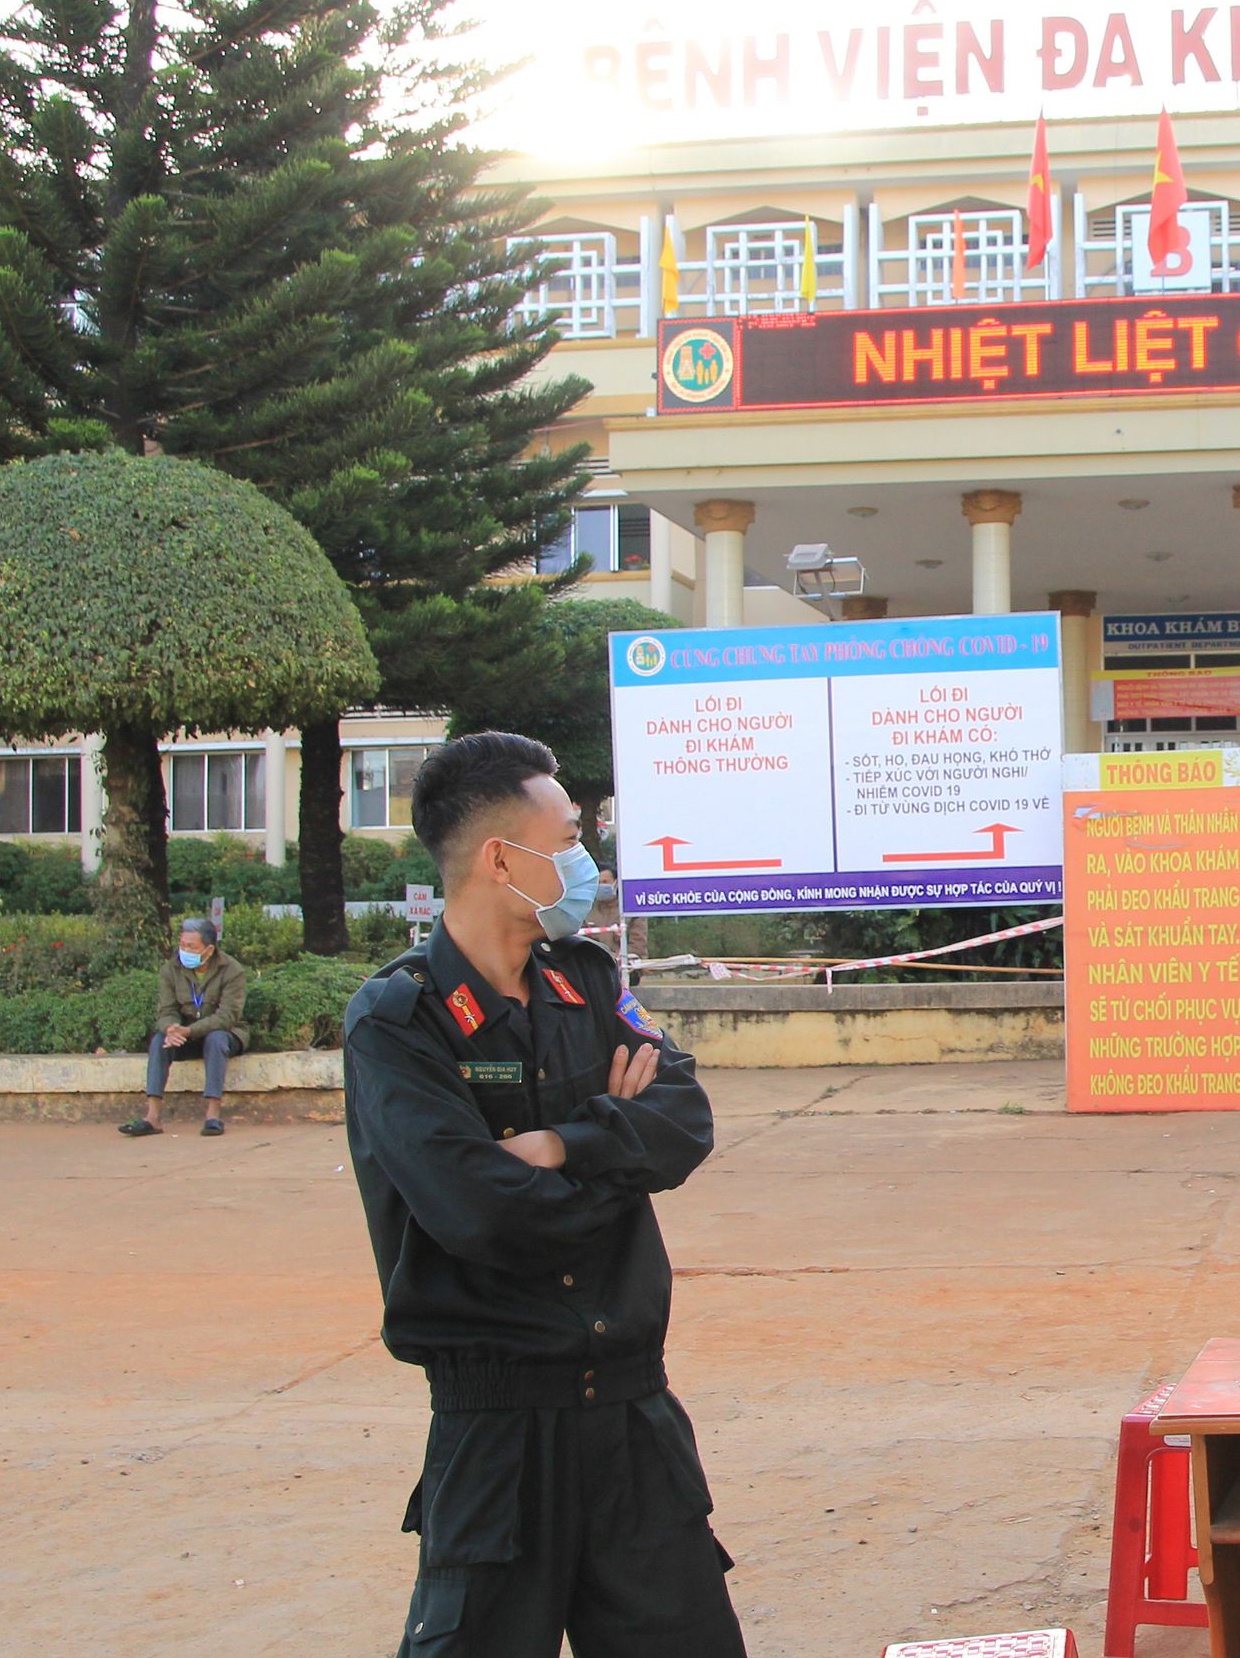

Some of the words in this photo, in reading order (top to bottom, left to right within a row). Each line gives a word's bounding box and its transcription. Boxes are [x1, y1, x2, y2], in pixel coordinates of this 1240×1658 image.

[818, 0, 1004, 116] VIỆN
[1036, 13, 1143, 91] ĐA
[854, 317, 1053, 390] NHIỆT
[1073, 310, 1219, 383] LIỆT
[1107, 622, 1160, 635] KHOA
[1165, 617, 1222, 634] KHÁM
[670, 644, 720, 669] CÙNG
[723, 645, 785, 668] CHUNG
[790, 643, 820, 664] TAY
[825, 635, 885, 661] PHÒNG
[958, 634, 1017, 656] COVID
[1032, 634, 1048, 654] 19
[725, 697, 742, 712] ĐI
[951, 687, 968, 702] ĐI
[646, 717, 692, 735] DÀNH
[697, 718, 732, 733] CHO
[737, 712, 793, 731] NGƯỜI
[872, 708, 918, 726] DÀNH
[924, 709, 960, 724] CHO
[965, 702, 1023, 722] NGƯỜI
[686, 740, 701, 753] ĐI
[707, 734, 754, 753] KHÁM
[892, 731, 909, 745] ĐI
[914, 725, 962, 745] KHÁM
[653, 757, 711, 775] THÔNG
[716, 753, 789, 773] THƯỜNG
[885, 754, 907, 767] HO,
[911, 753, 939, 766] ĐAU
[989, 748, 1018, 762] KHÓ
[885, 768, 912, 782] XÚC
[943, 765, 988, 780] NGƯỜI
[992, 766, 1028, 779] NGHI/
[1106, 759, 1173, 785] THÔNG
[1177, 757, 1216, 782] BÁO
[902, 785, 942, 798] COVID
[947, 784, 961, 797] 19
[855, 804, 867, 816] ĐI
[893, 799, 930, 814] VÙNG
[934, 800, 965, 816] DỊCH
[969, 798, 1011, 812] COVID
[1015, 797, 1028, 810] 19
[1126, 810, 1154, 840] BỆNH
[1157, 809, 1172, 835] VÀ
[1174, 808, 1203, 834] THÂN
[1207, 806, 1238, 832] NHÂN
[1086, 853, 1110, 877] RA,
[1114, 848, 1146, 873] VÀO
[1150, 851, 1192, 873] KHOA
[1196, 845, 1239, 872] KHÁM
[648, 891, 670, 905] SỨC
[705, 889, 726, 902] CỦA
[729, 888, 759, 904] CỘNG
[797, 885, 822, 900] KÍNH
[825, 886, 857, 900] MONG
[859, 884, 889, 901] NHẬN
[891, 883, 924, 899] ĐƯỢC
[926, 883, 943, 898] SỰ
[944, 882, 967, 897] HỢP
[970, 880, 992, 894] TÁC
[994, 879, 1018, 894] CỦA
[1020, 878, 1042, 894] QUÝ
[1044, 880, 1056, 896] VỊ
[1087, 884, 1118, 910] PHẢI
[1121, 889, 1150, 910] ĐEO
[1154, 880, 1189, 909] KHẨU
[1193, 886, 1240, 908] TRANG
[1088, 922, 1110, 947] VÀ
[1114, 921, 1143, 947] SÁT
[1148, 916, 1203, 946] KHUẨN
[1208, 924, 1240, 945] TAY.
[1088, 959, 1143, 984] NHÂN
[1149, 957, 1192, 983] VIÊN
[1199, 962, 1211, 982] Y
[1216, 953, 1240, 982] TẾ
[1090, 995, 1107, 1021] SẼ
[1111, 995, 1131, 1021] TỪ
[1133, 992, 1171, 1020] CHỐI
[1176, 998, 1217, 1025] PHỤC
[1089, 1032, 1141, 1058] NHỮNG
[1145, 1032, 1207, 1057] TRƯỜNG
[1090, 1069, 1134, 1095] KHÔNG
[1137, 1074, 1163, 1095] ĐEO
[1166, 1065, 1198, 1094] KHẨU
